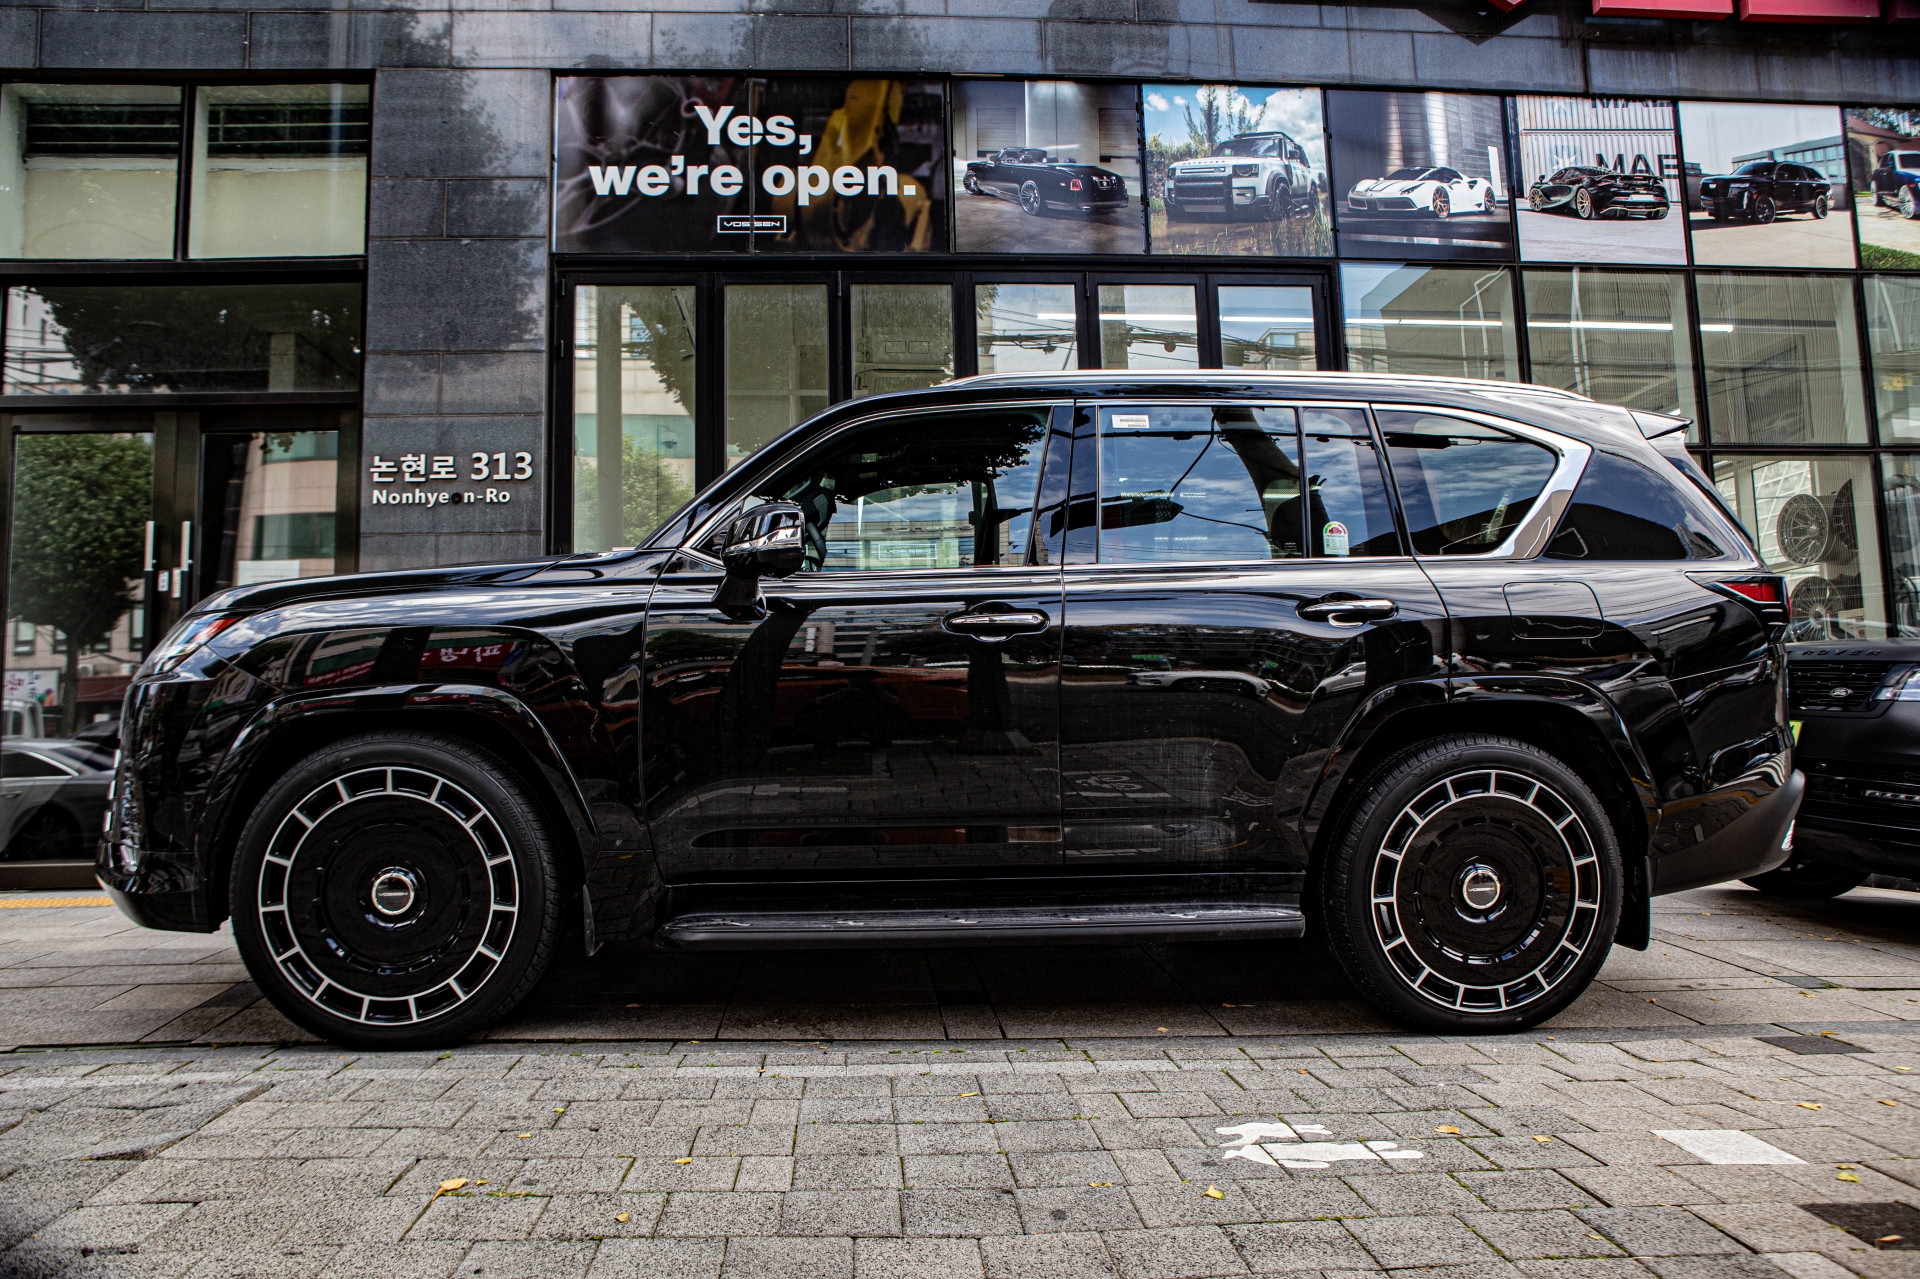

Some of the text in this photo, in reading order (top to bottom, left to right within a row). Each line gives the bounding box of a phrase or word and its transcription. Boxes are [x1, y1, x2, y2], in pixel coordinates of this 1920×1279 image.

[694, 105, 812, 155] Yes,
[588, 155, 917, 206] we're open.
[369, 451, 533, 483] 논현로 313
